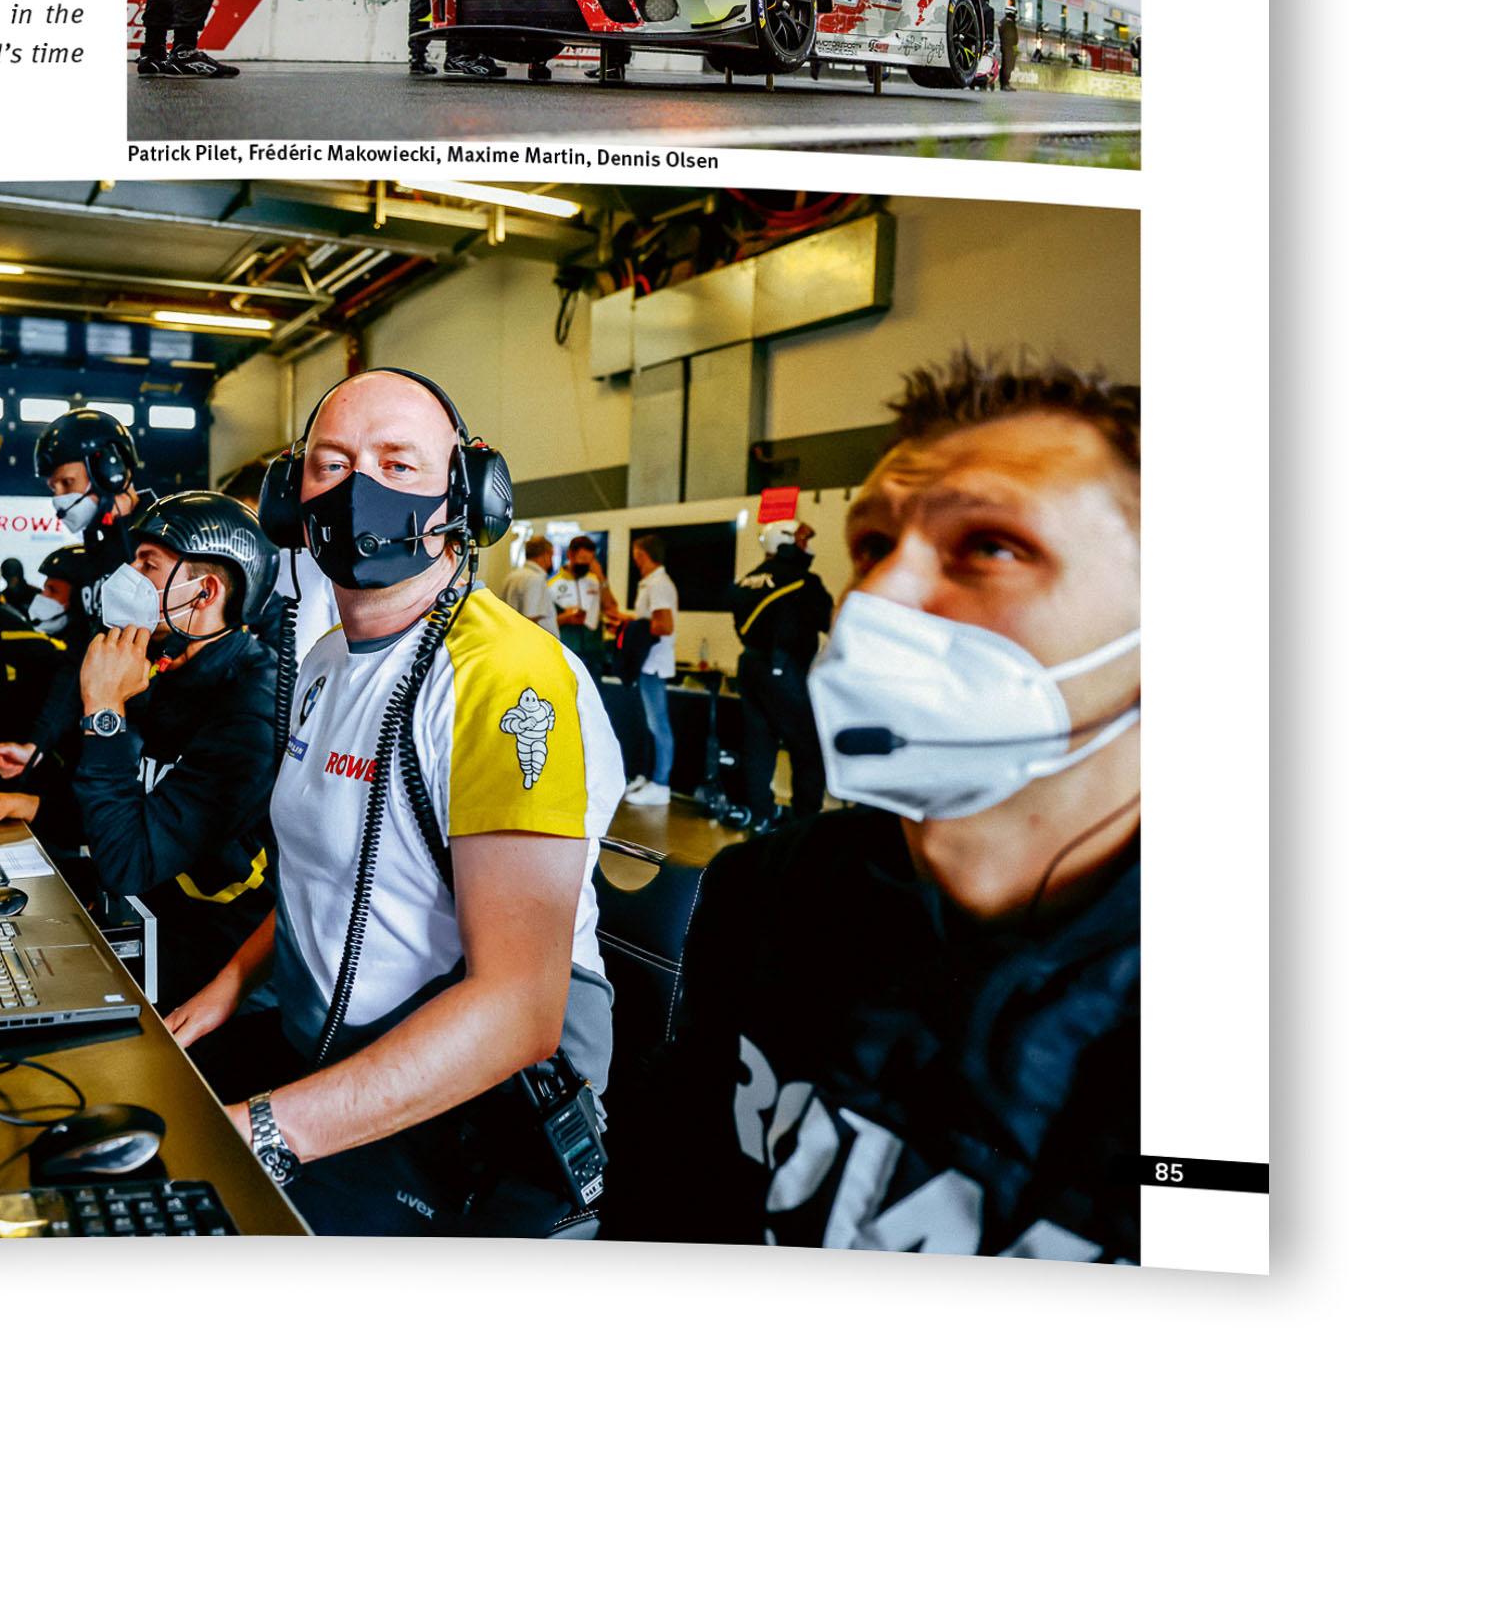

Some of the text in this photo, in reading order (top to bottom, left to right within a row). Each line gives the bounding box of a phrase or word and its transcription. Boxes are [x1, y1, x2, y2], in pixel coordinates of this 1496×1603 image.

[128, 143, 718, 169] Patrick Pilet, Frédéric Makowiecki, Maxime Martin, Dennis Olsen
[1154, 1162, 1185, 1183] 85
[396, 1189, 437, 1221] uvex
